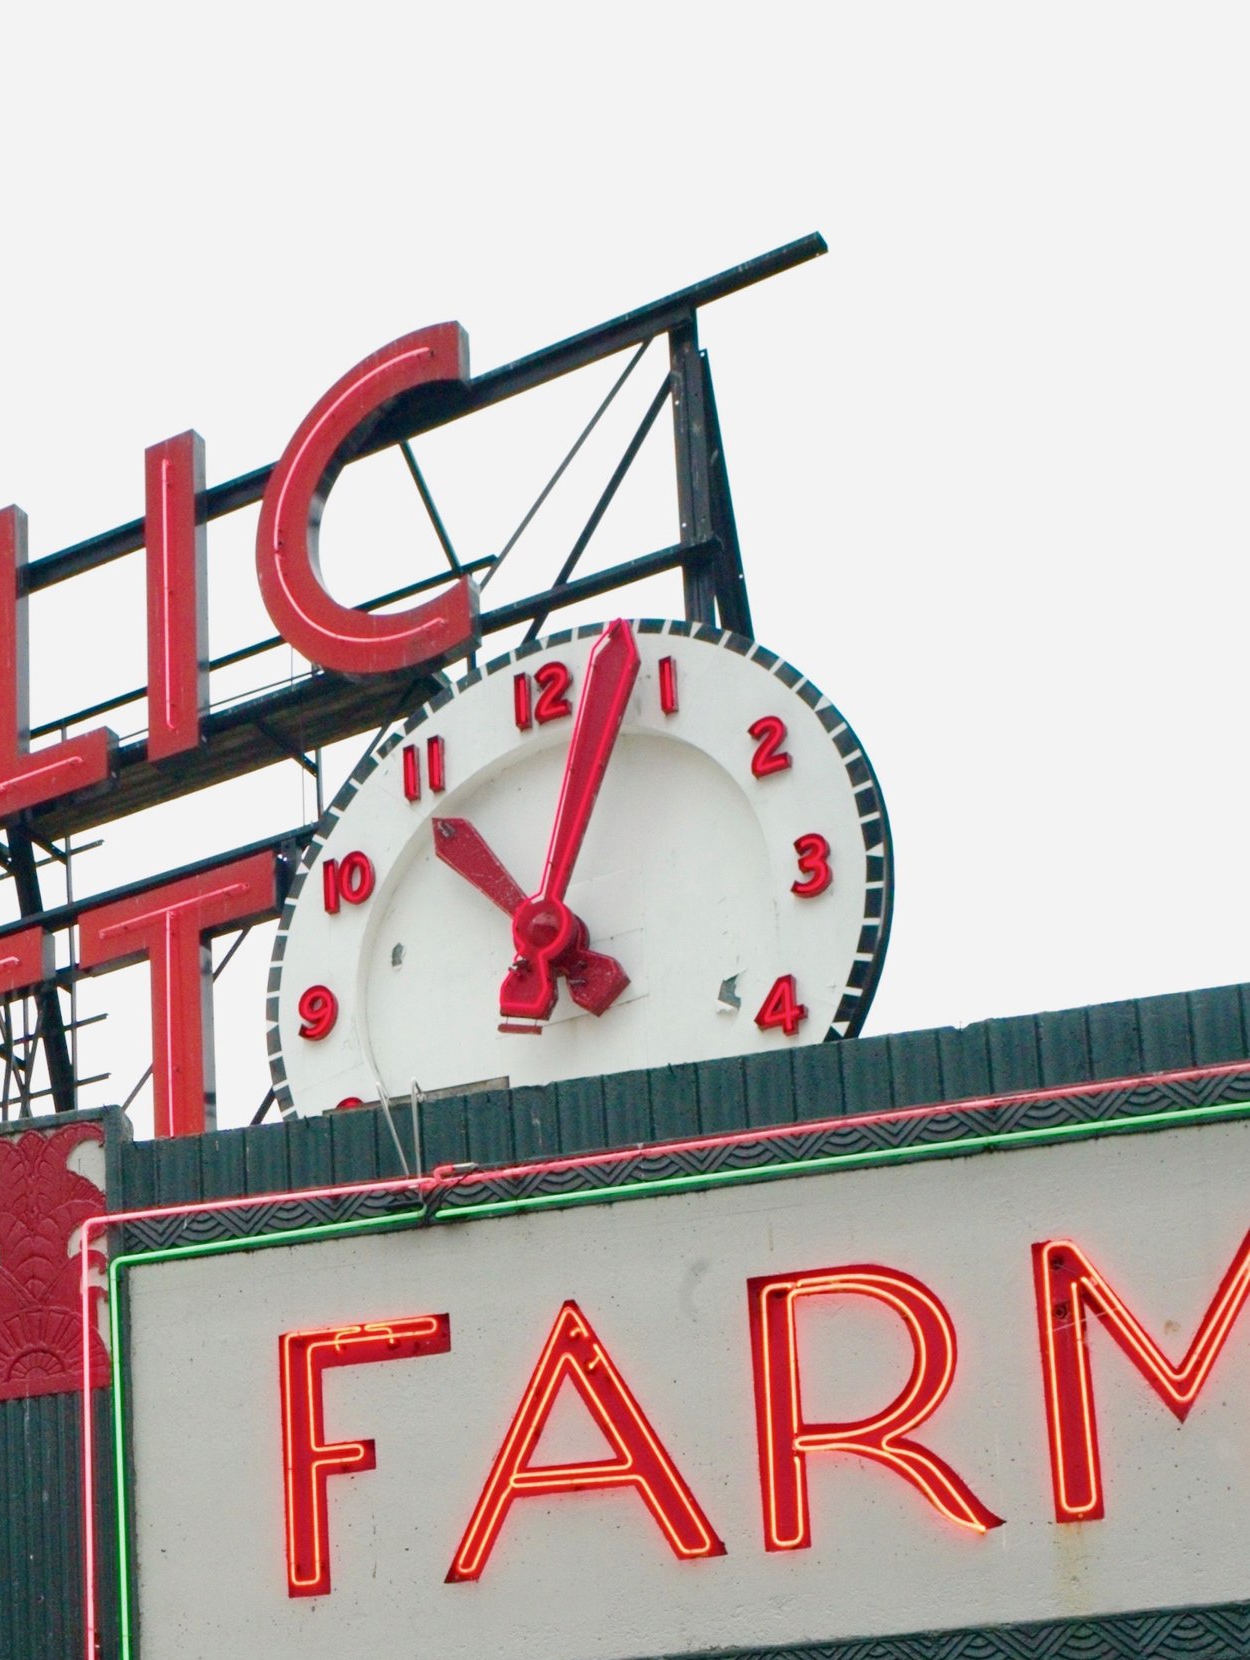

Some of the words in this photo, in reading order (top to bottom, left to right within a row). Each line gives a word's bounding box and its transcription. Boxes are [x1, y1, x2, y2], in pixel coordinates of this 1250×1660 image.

[513, 661, 574, 730] 12
[658, 655, 680, 715] 1
[403, 735, 446, 801] 11
[748, 715, 793, 778] 2
[322, 850, 376, 914] 10
[790, 833, 833, 898] 3
[298, 985, 339, 1041] 9
[754, 974, 809, 1036] 4
[278, 1227, 1250, 1598] FARM
